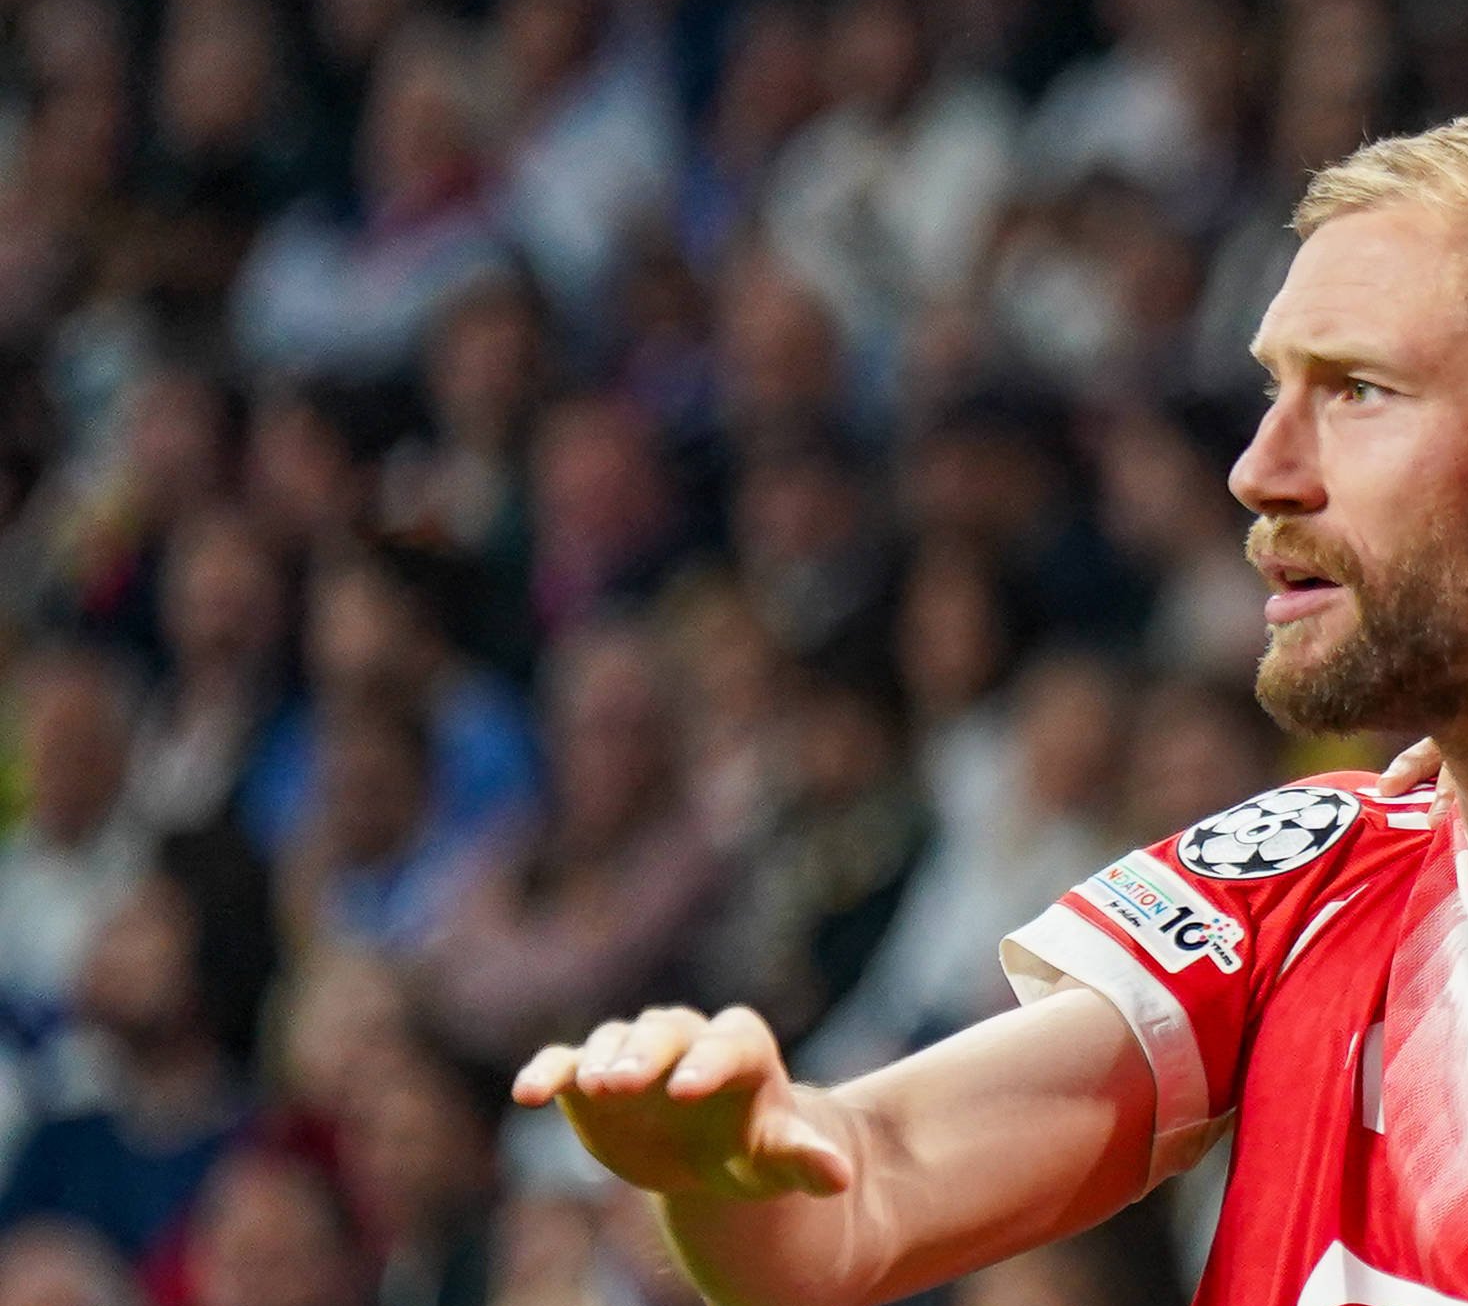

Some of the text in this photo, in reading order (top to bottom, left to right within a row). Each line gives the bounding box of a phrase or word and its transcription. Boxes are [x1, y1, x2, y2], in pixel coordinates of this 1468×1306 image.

[1107, 867, 1169, 916] NDATION
[1158, 906, 1211, 951] 10
[1211, 941, 1233, 966] YEARS
